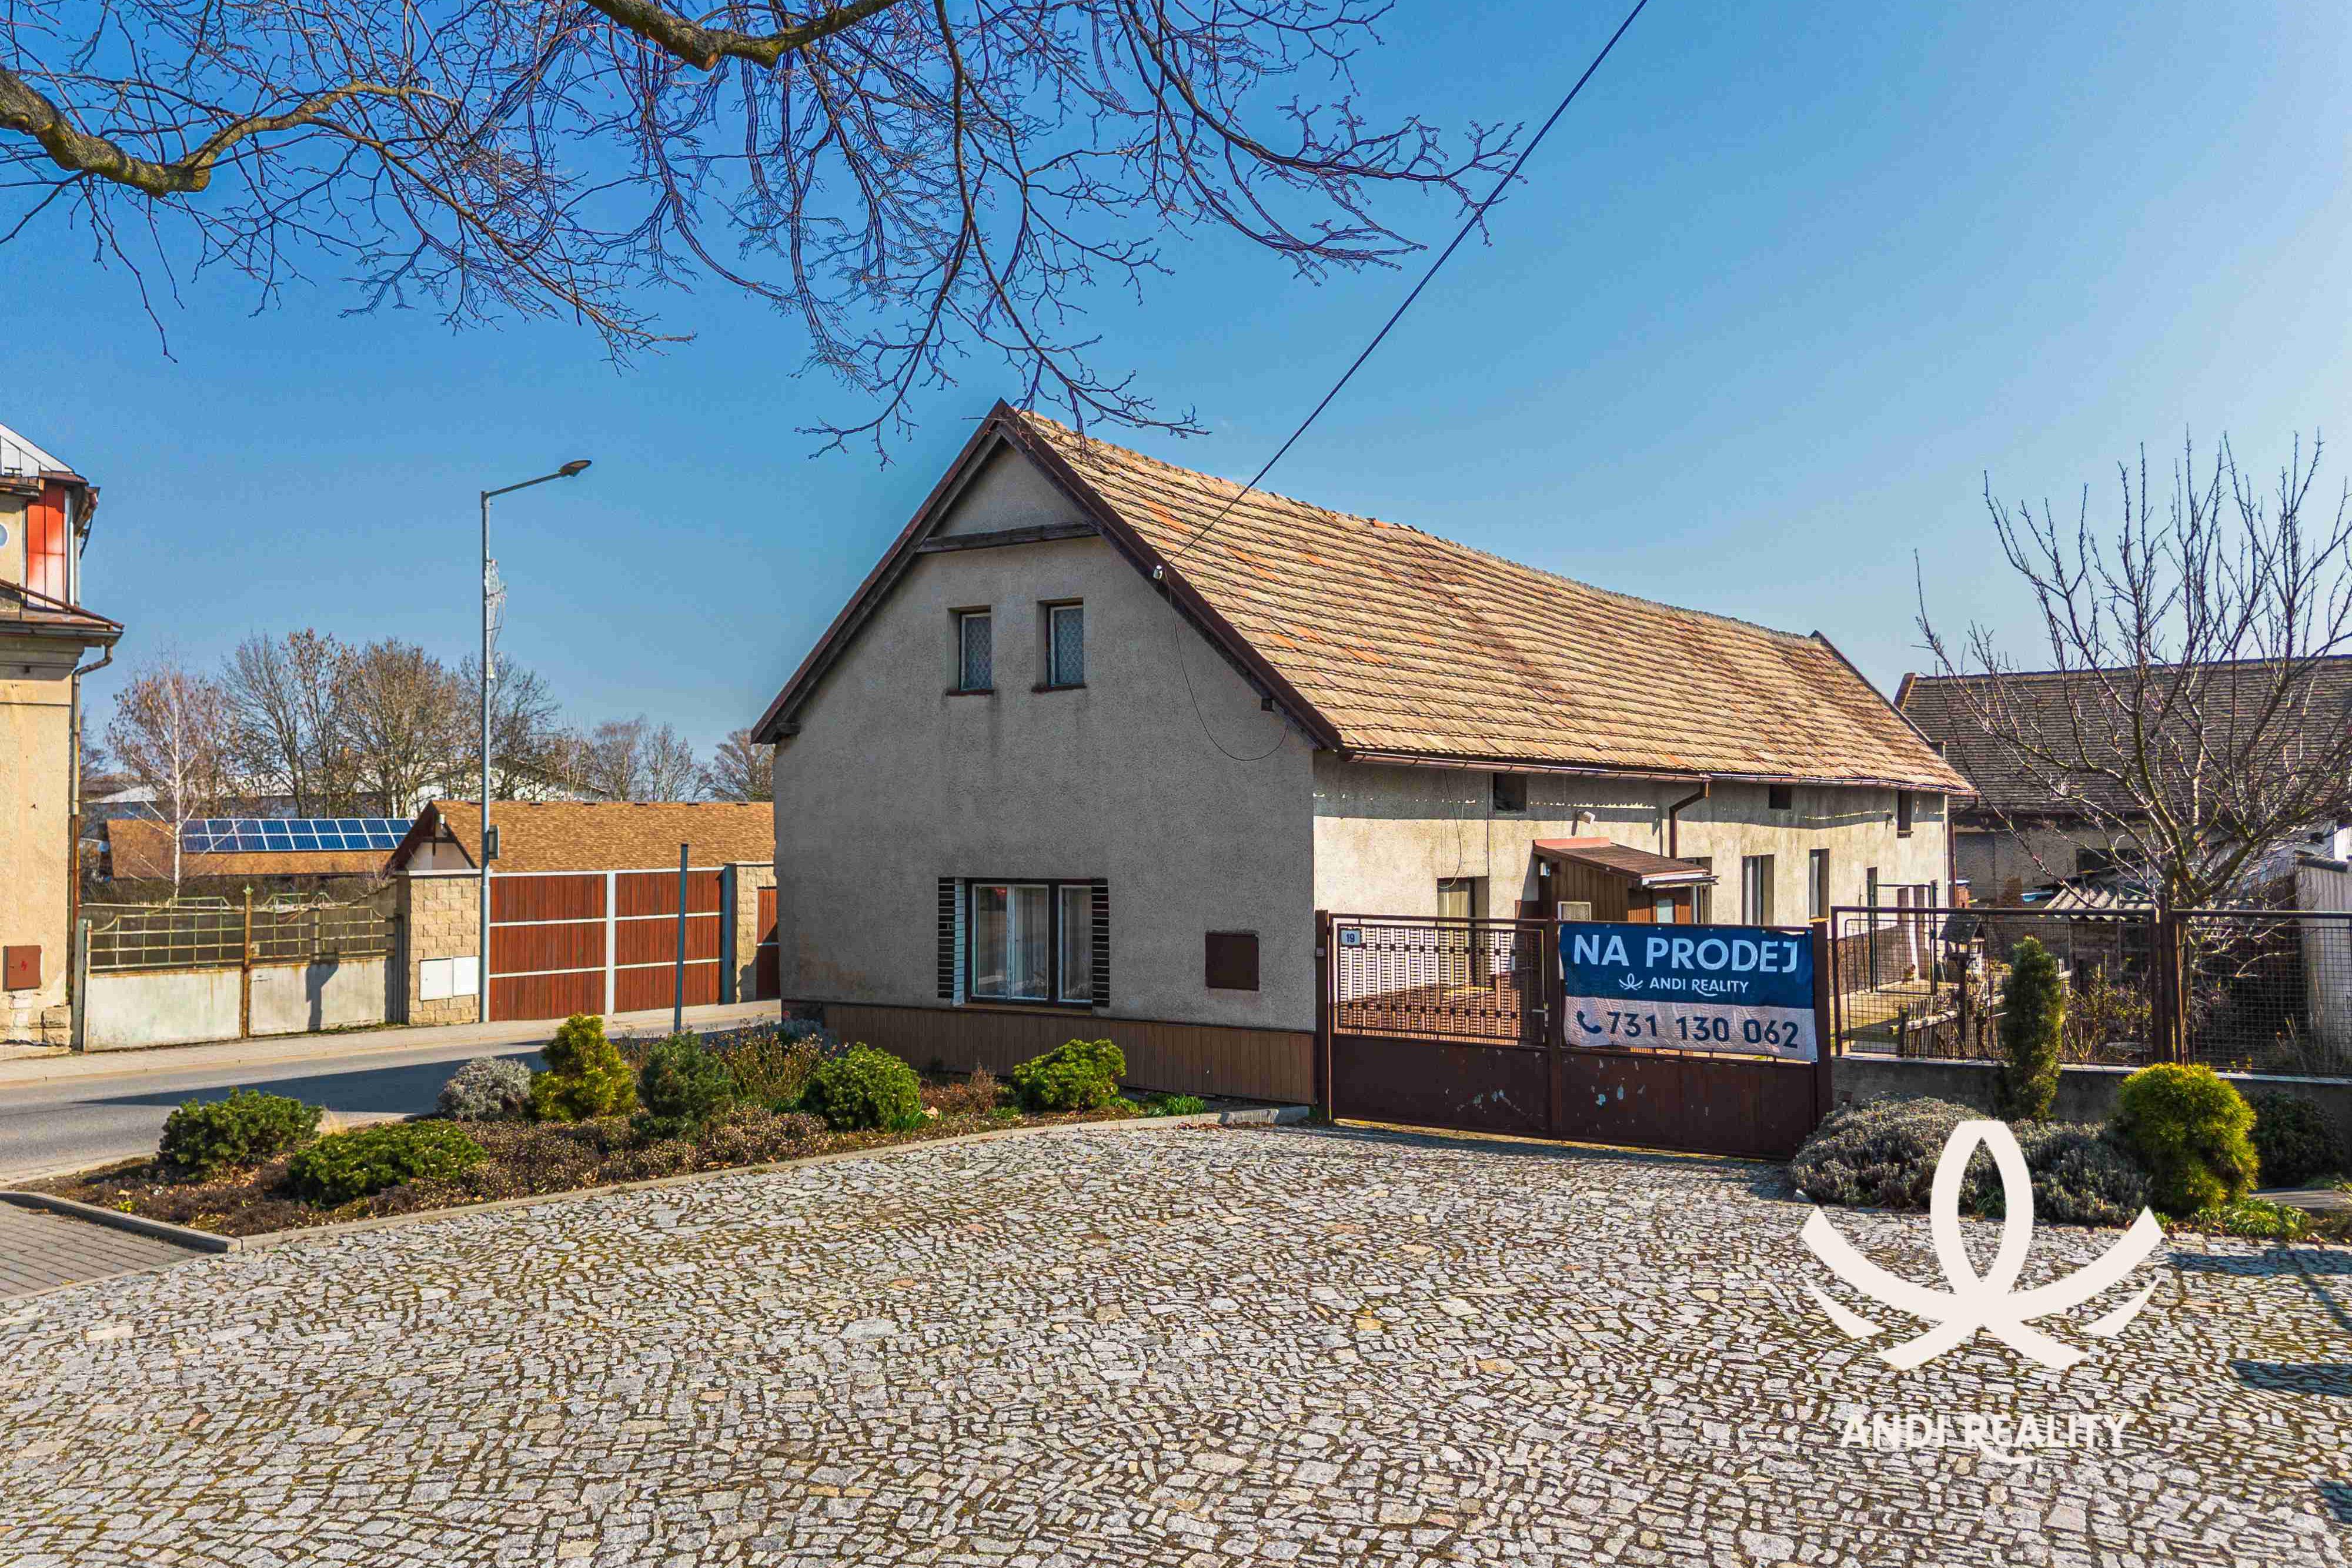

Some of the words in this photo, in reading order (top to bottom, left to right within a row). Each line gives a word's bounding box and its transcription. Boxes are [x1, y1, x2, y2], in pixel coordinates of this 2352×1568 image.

[1346, 933, 1355, 942] 19
[1573, 934, 1629, 967] NA
[1646, 937, 1797, 973] PRODEJ
[1649, 977, 1686, 990] ANDI
[1691, 979, 1749, 997] REALITY
[1607, 1012, 1658, 1037] 731
[1676, 1017, 1730, 1042] 130
[1743, 1019, 1798, 1048] 062
